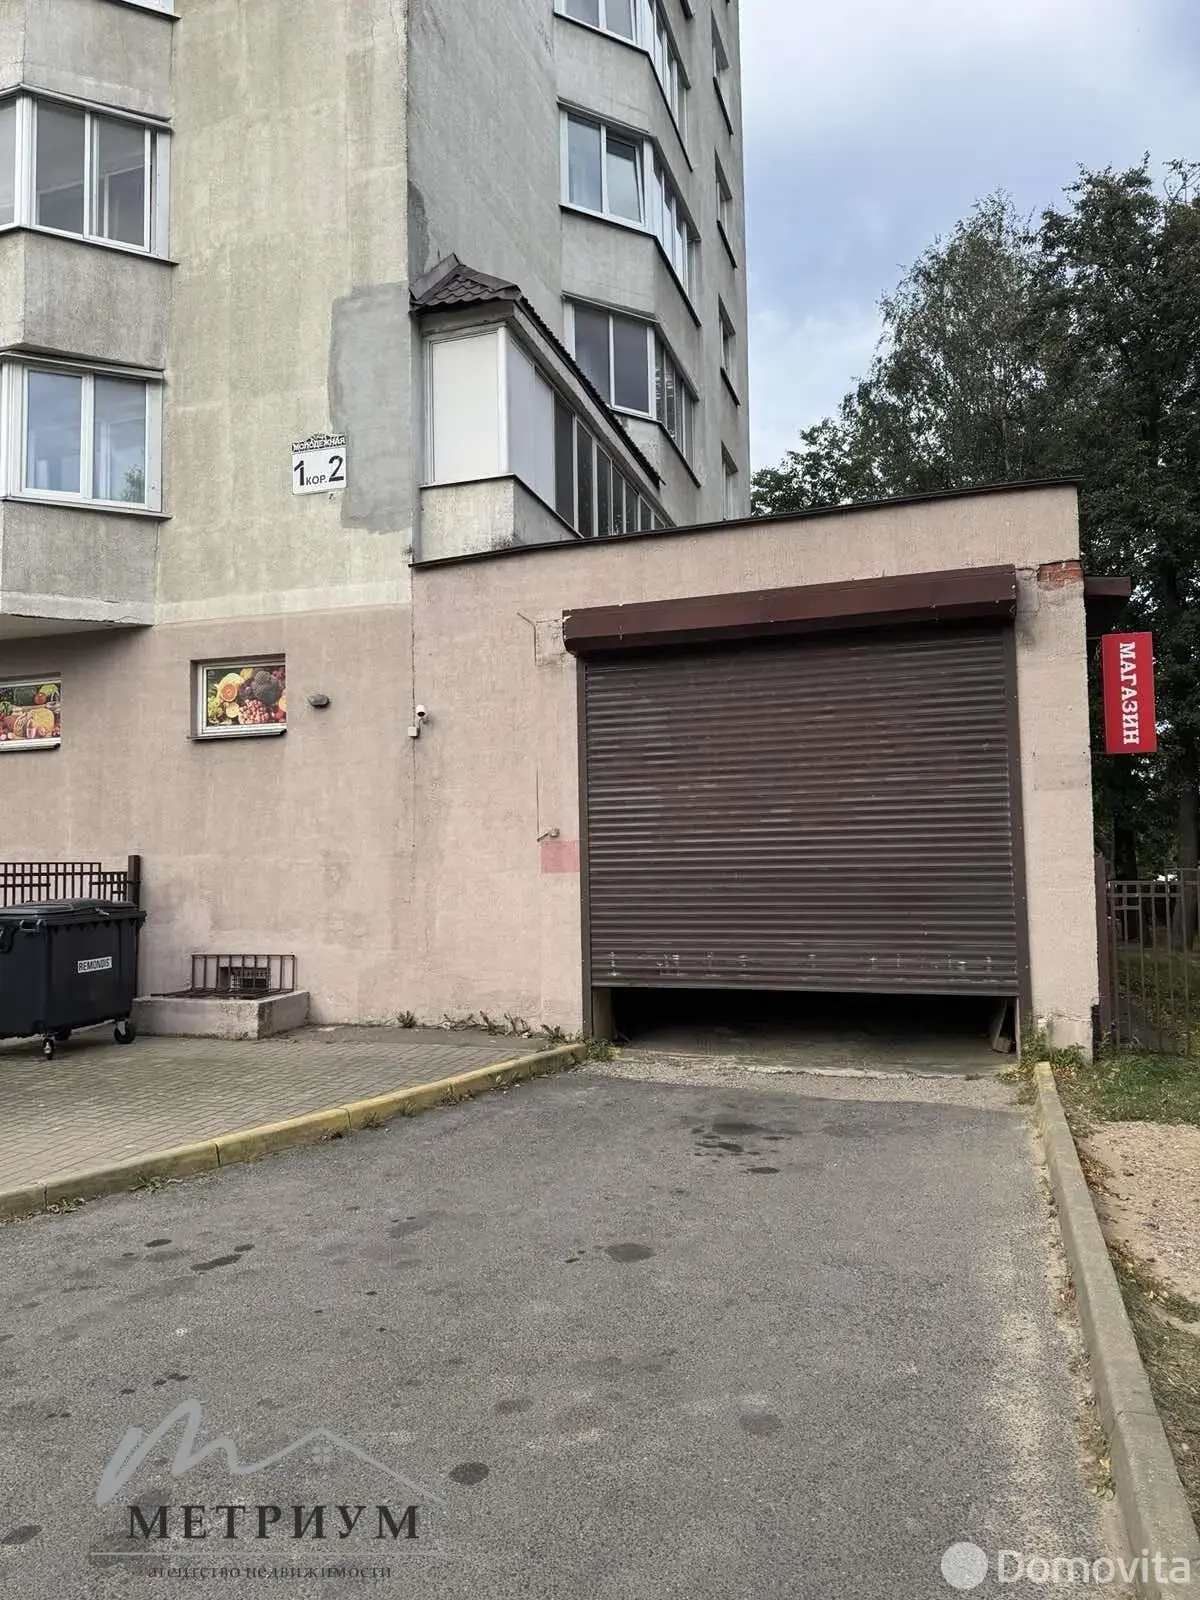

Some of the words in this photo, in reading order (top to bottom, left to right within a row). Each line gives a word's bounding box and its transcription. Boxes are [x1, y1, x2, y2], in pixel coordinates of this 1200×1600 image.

[294, 460, 304, 486] 1
[329, 455, 344, 482] 2
[1120, 641, 1140, 745] МАГАЗИН
[78, 957, 111, 972] REMONDIS
